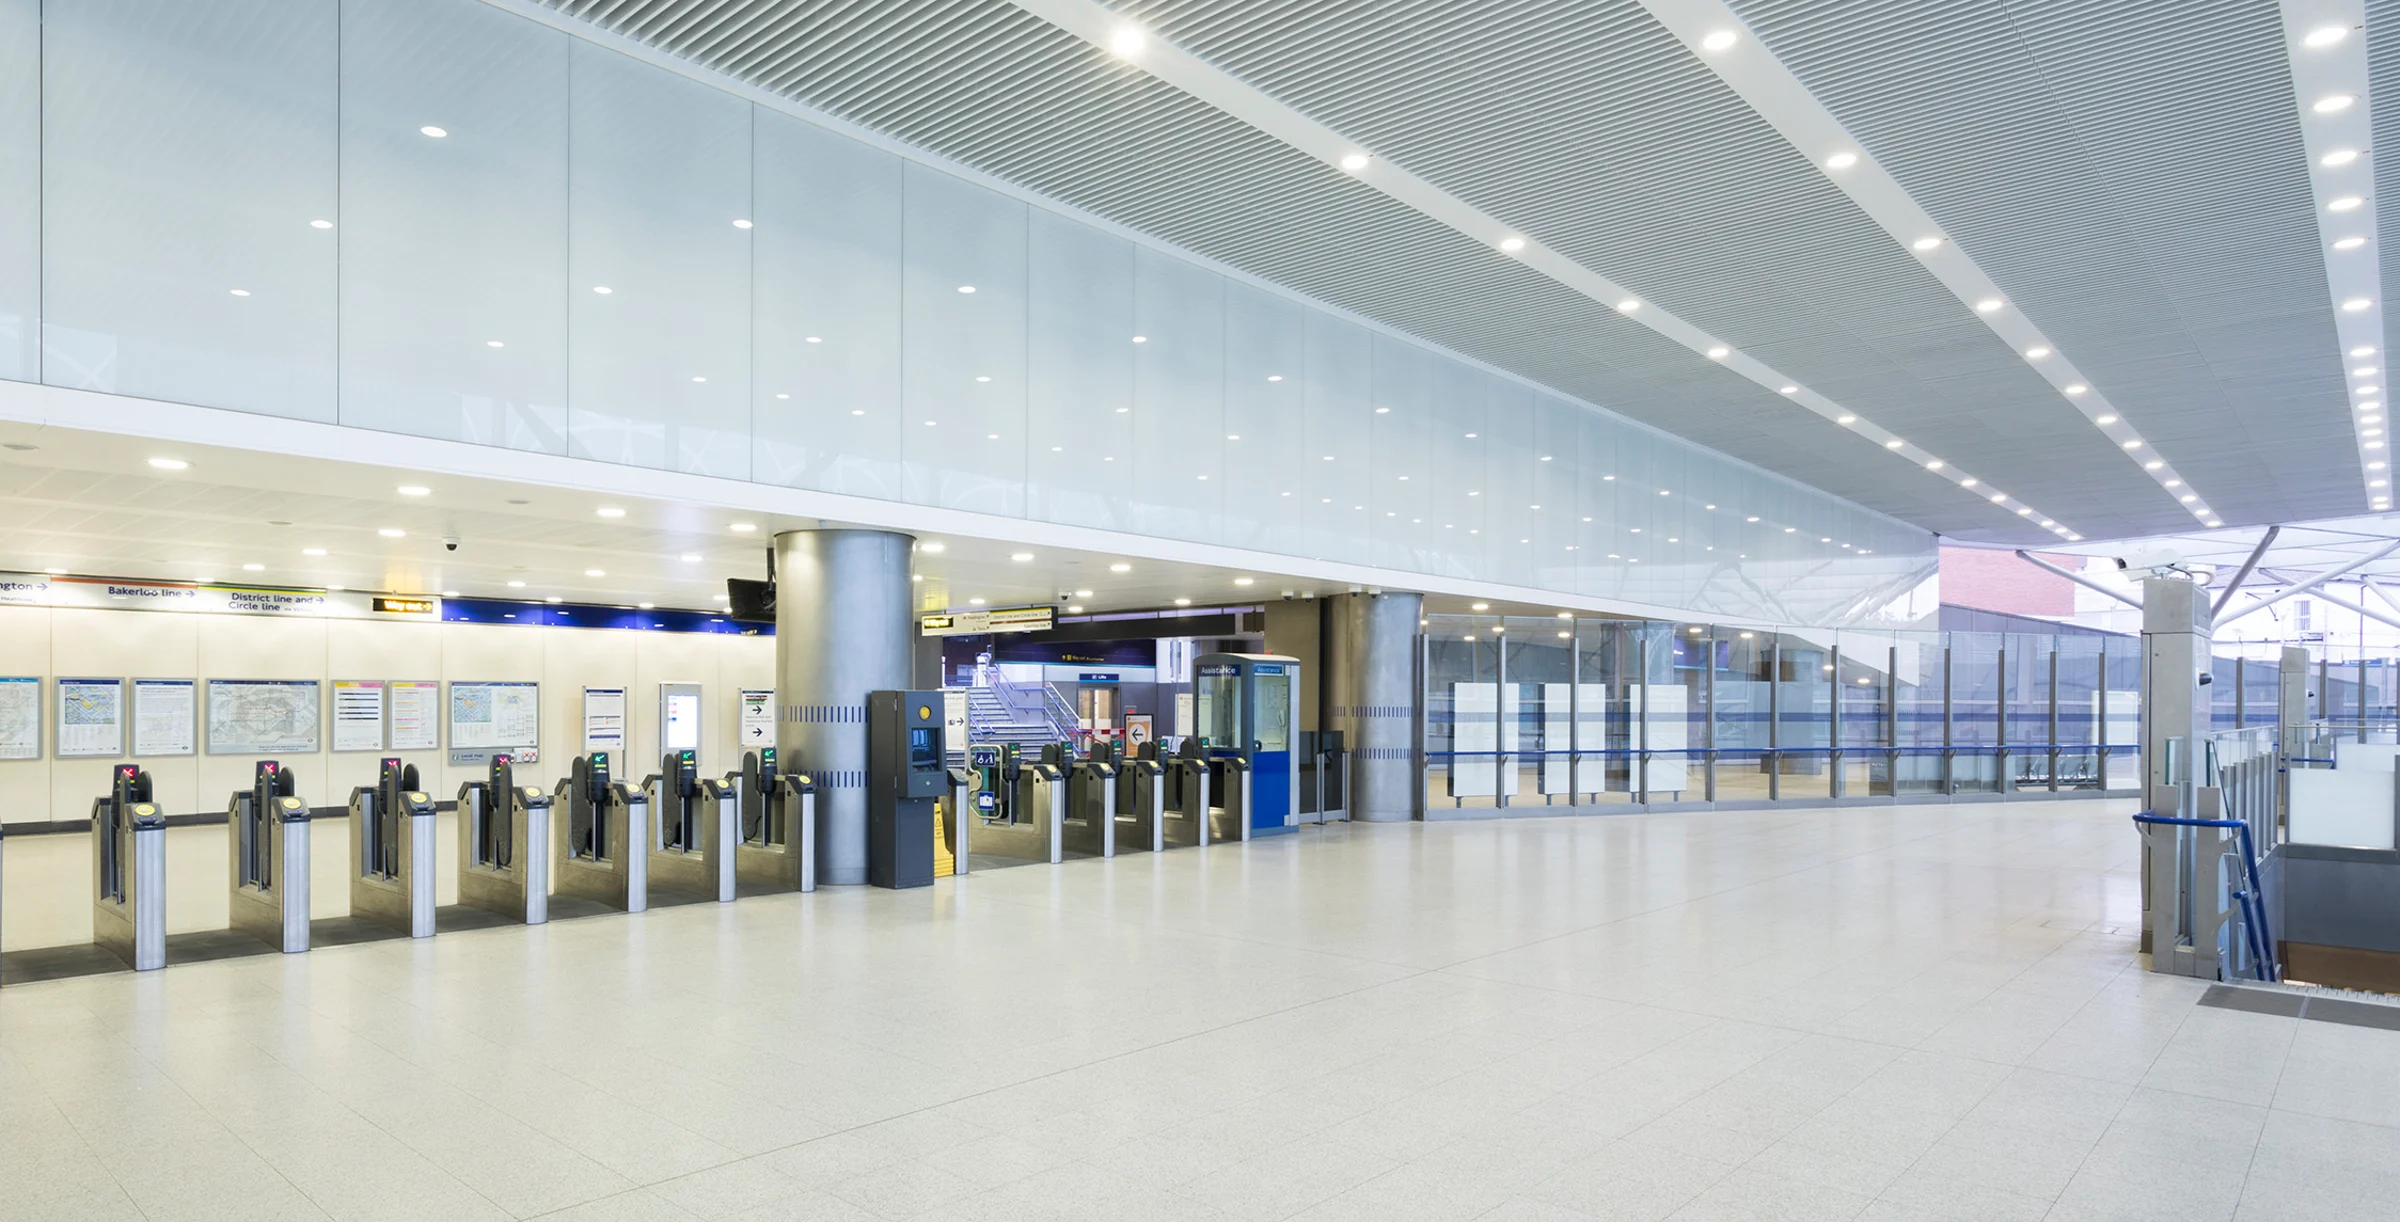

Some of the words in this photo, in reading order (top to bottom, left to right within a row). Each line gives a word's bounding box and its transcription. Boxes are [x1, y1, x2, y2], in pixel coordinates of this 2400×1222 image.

[108, 586, 158, 597] Bakerloo
[161, 588, 182, 597] line
[232, 592, 270, 603] District
[273, 594, 292, 604] line
[295, 596, 314, 604] and
[228, 601, 258, 610] Circle
[261, 602, 281, 611] line
[1201, 666, 1236, 674] Assistance
